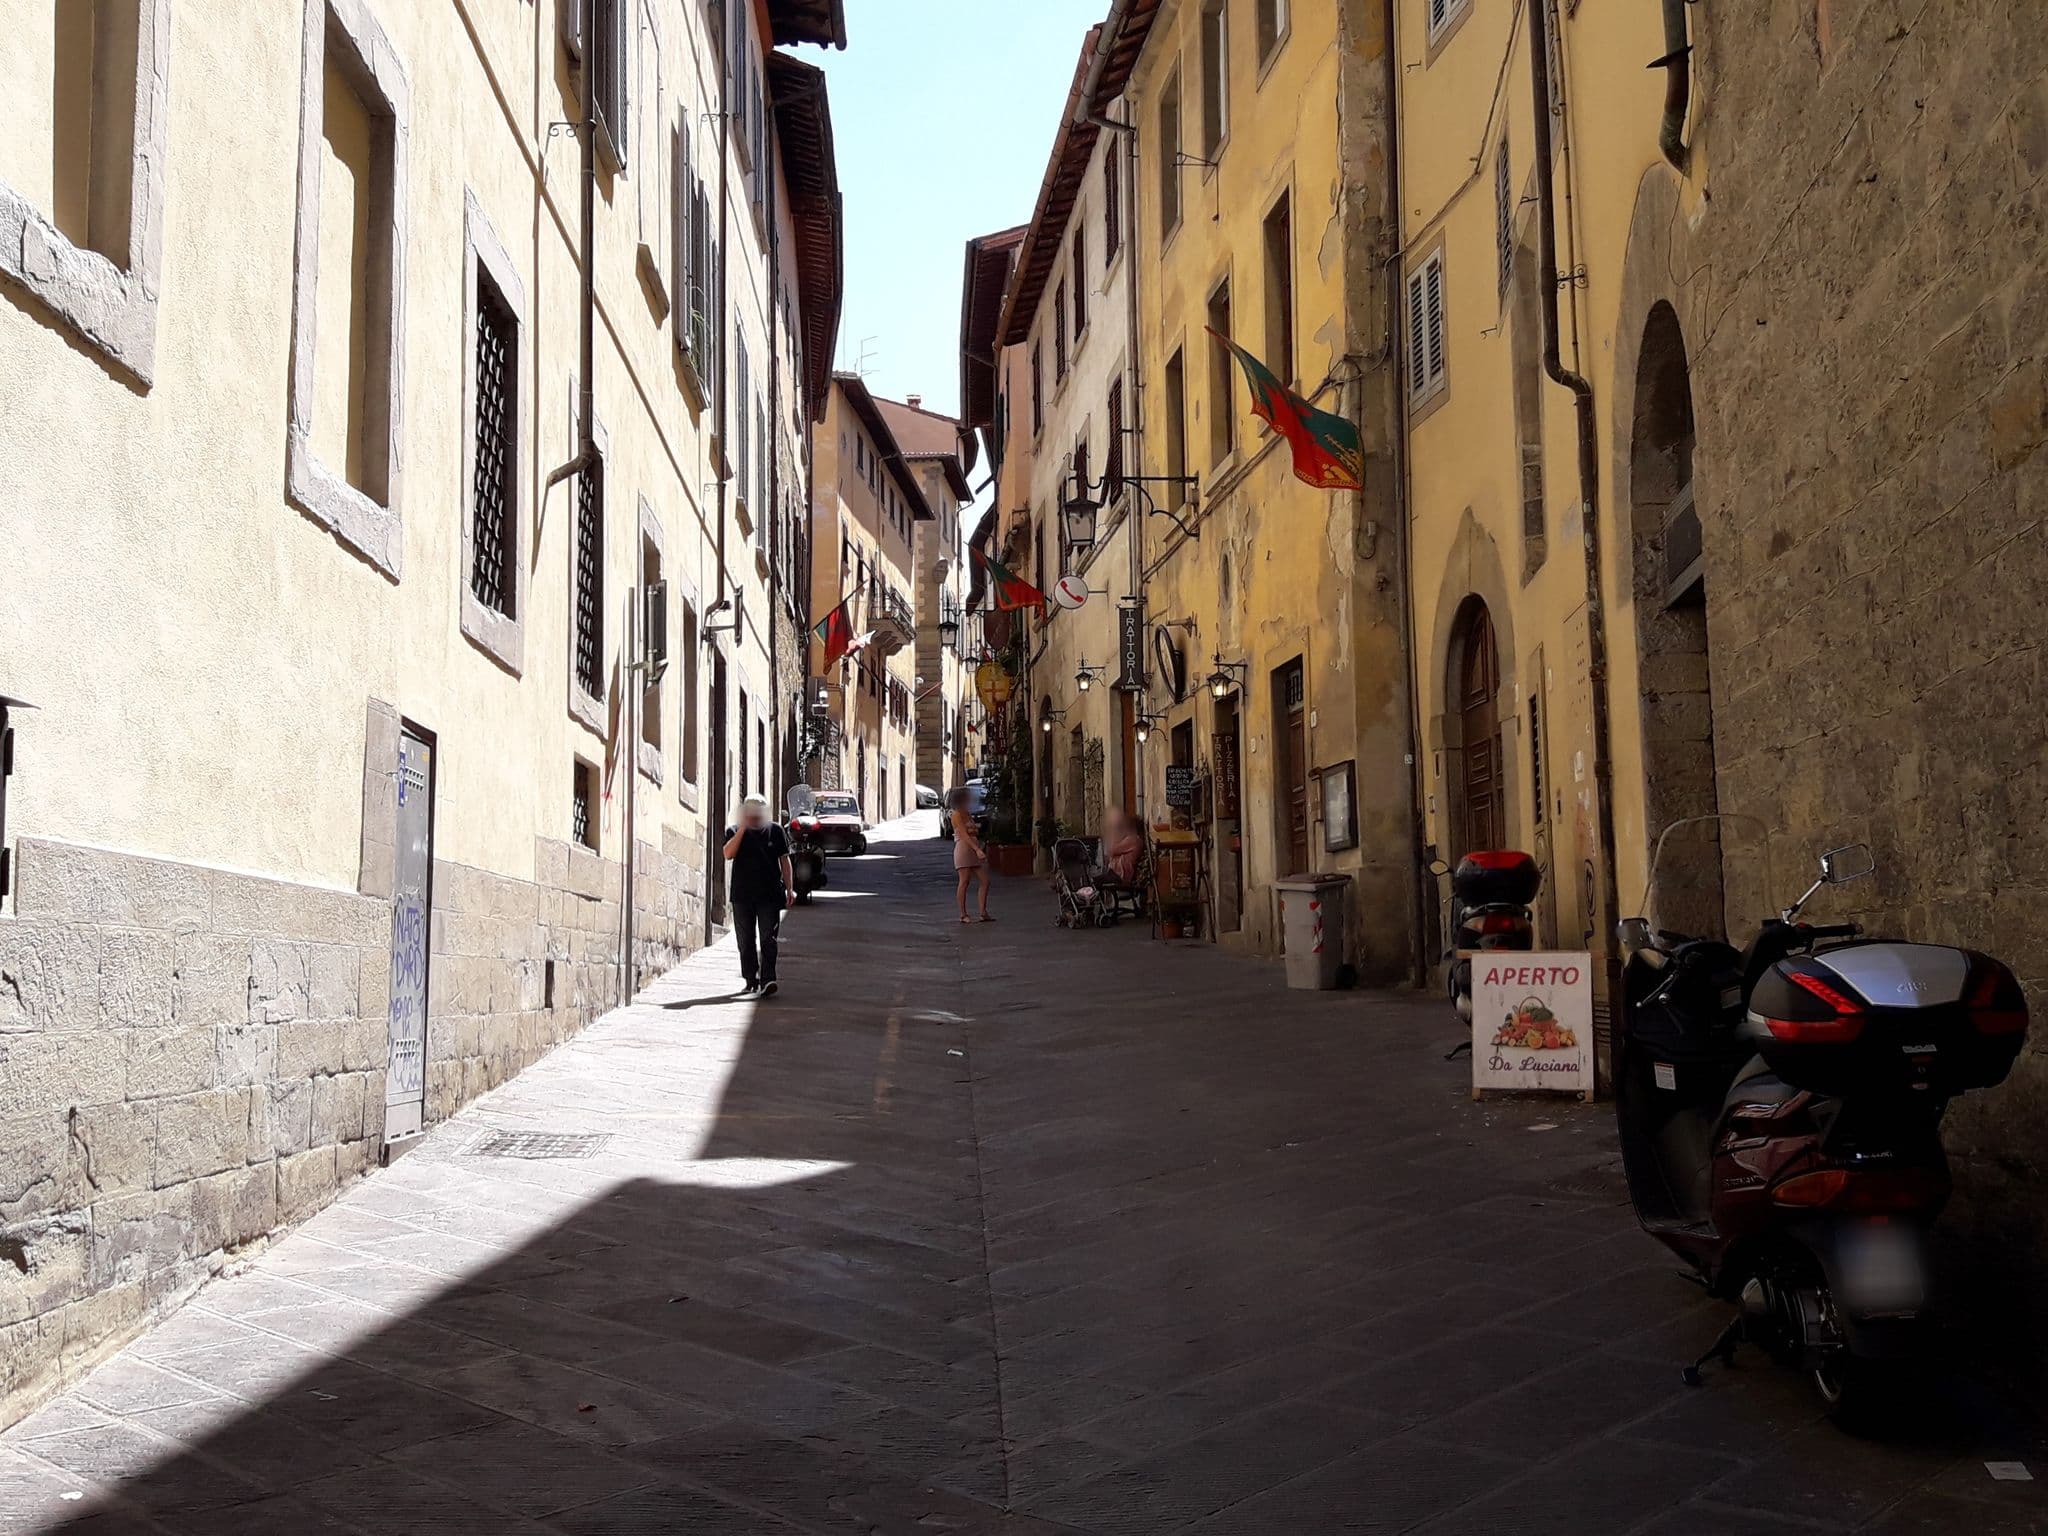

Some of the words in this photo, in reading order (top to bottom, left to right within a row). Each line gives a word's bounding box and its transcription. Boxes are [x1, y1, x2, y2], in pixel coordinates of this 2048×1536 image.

[1125, 609, 1136, 685] TRATTORIA
[1215, 736, 1225, 806] TRATTORIA
[1224, 735, 1236, 798] PIZZERIA
[1484, 967, 1580, 986] APERTO
[1488, 1055, 1513, 1072] Da
[1518, 1055, 1579, 1073] Luciana
